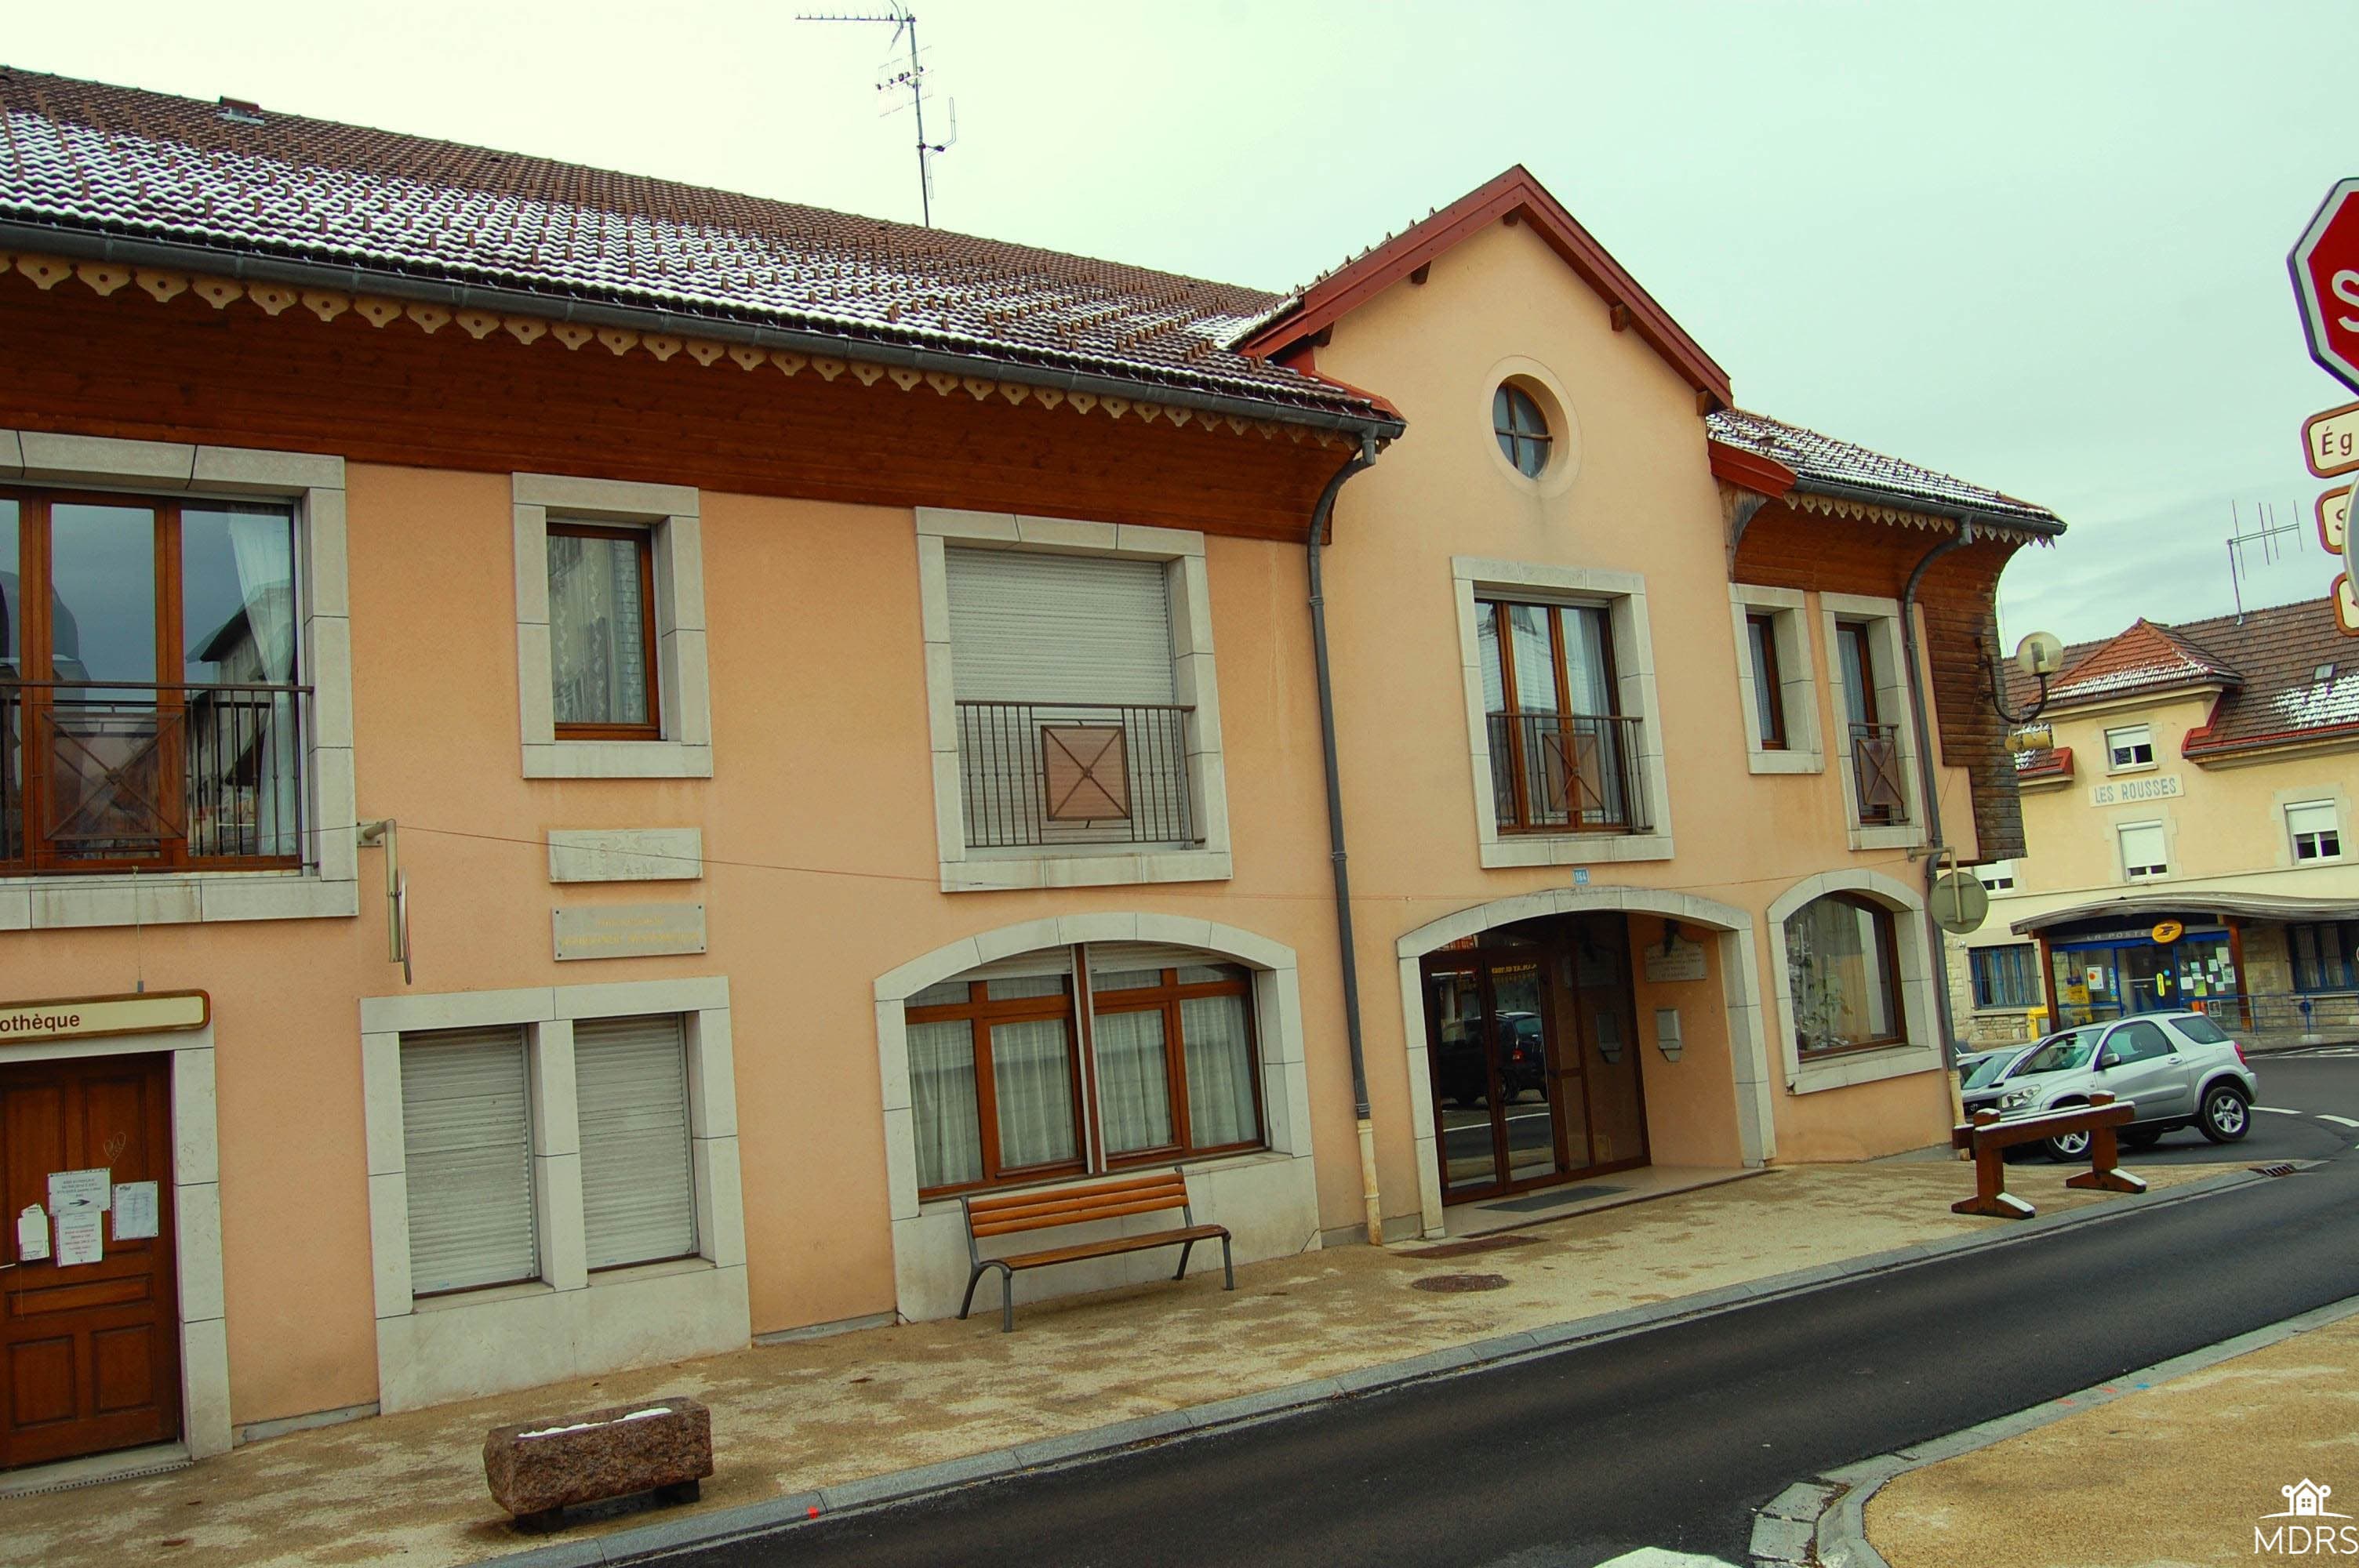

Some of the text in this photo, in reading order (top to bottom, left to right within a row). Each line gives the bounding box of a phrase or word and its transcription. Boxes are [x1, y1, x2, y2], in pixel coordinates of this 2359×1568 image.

[2095, 777, 2176, 804] LES ROUSSES
[2109, 930, 2146, 939] POSTE
[0, 1013, 80, 1032] othèque
